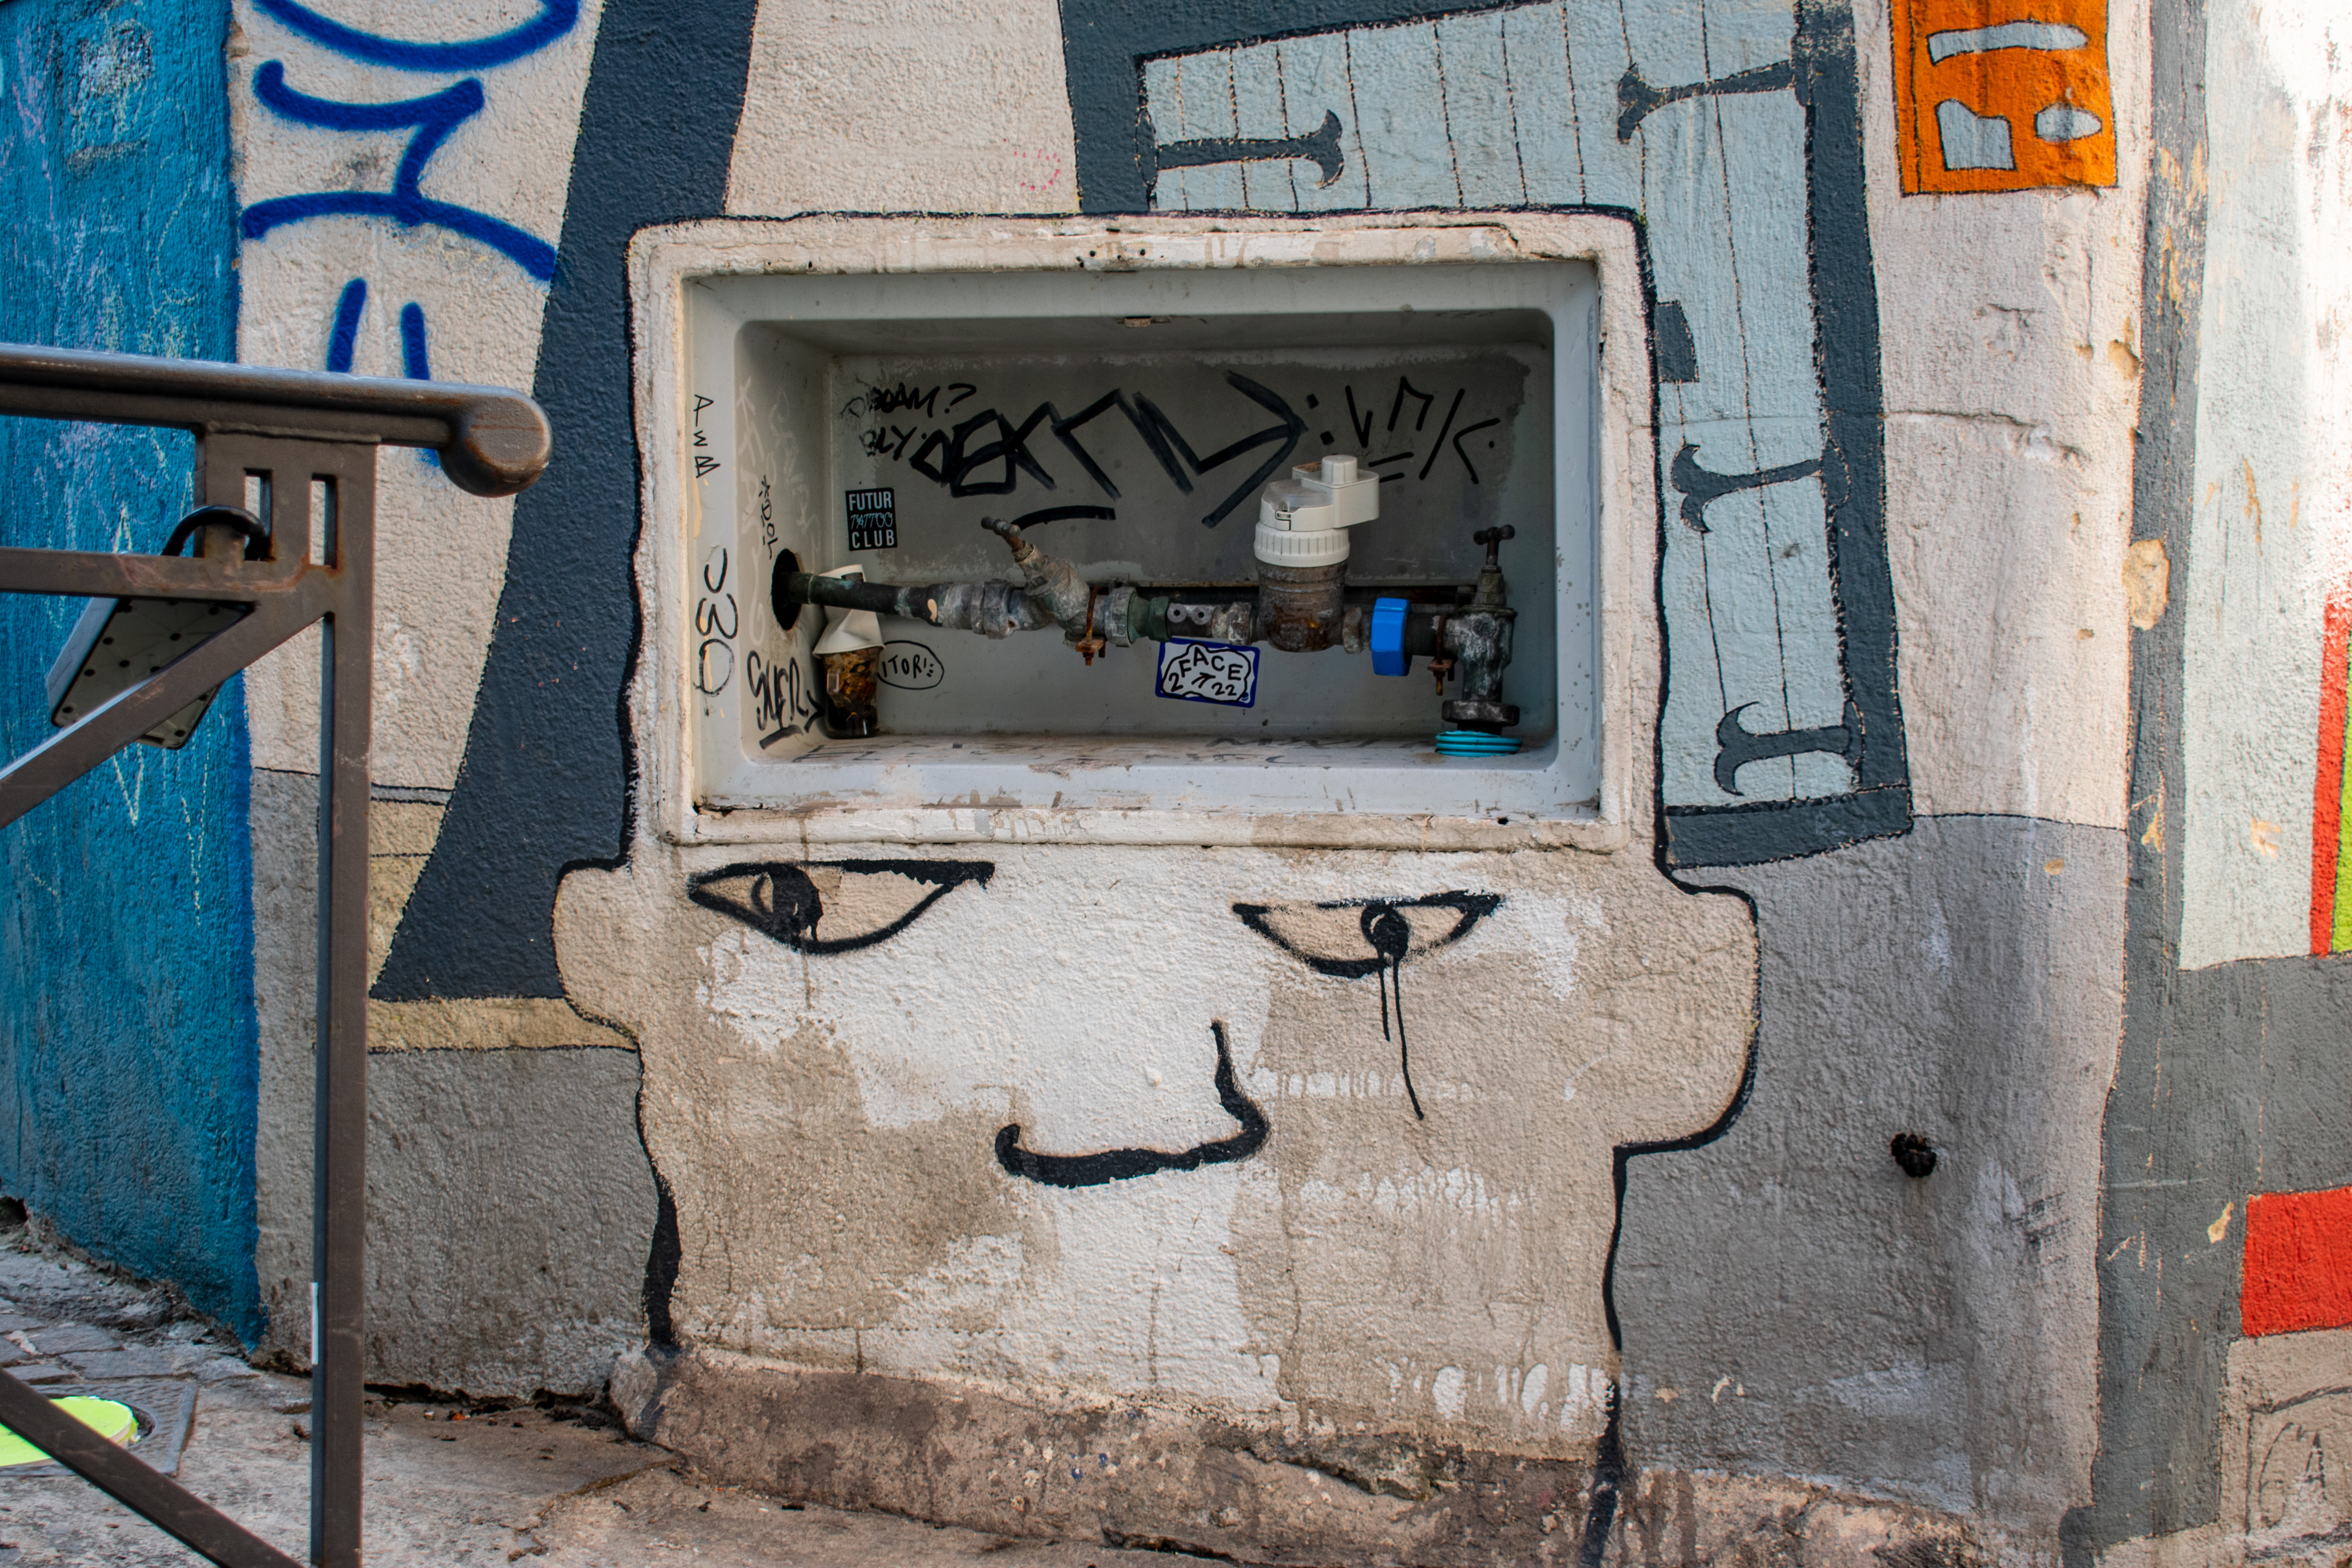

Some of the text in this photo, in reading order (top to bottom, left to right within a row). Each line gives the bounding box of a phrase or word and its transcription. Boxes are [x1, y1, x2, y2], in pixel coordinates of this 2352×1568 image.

[849, 491, 892, 511] FUTUR
[850, 512, 893, 529] TATTOO
[851, 529, 895, 548] CLUB
[1211, 682, 1237, 696] 22
